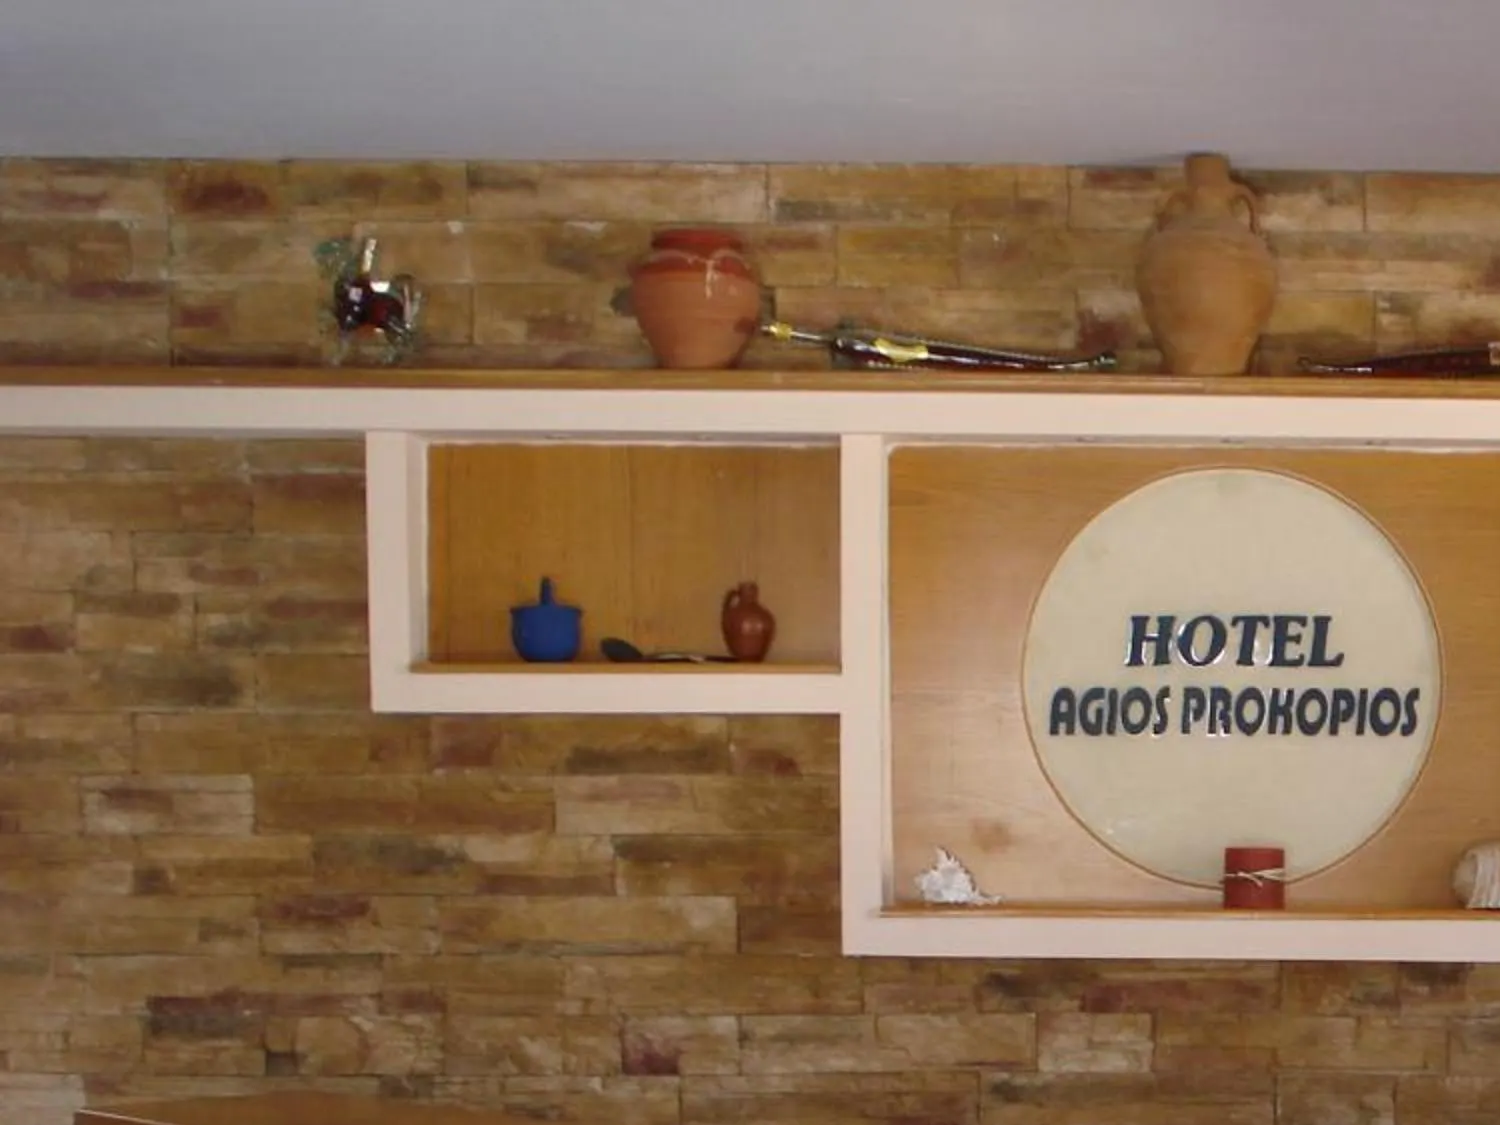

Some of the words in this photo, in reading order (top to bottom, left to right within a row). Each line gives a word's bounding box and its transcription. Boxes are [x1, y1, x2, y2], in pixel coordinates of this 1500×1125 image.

[1125, 614, 1345, 667] HOTEL
[1049, 686, 1171, 736] AGIOS
[1180, 686, 1420, 737] PROKOPIOS
